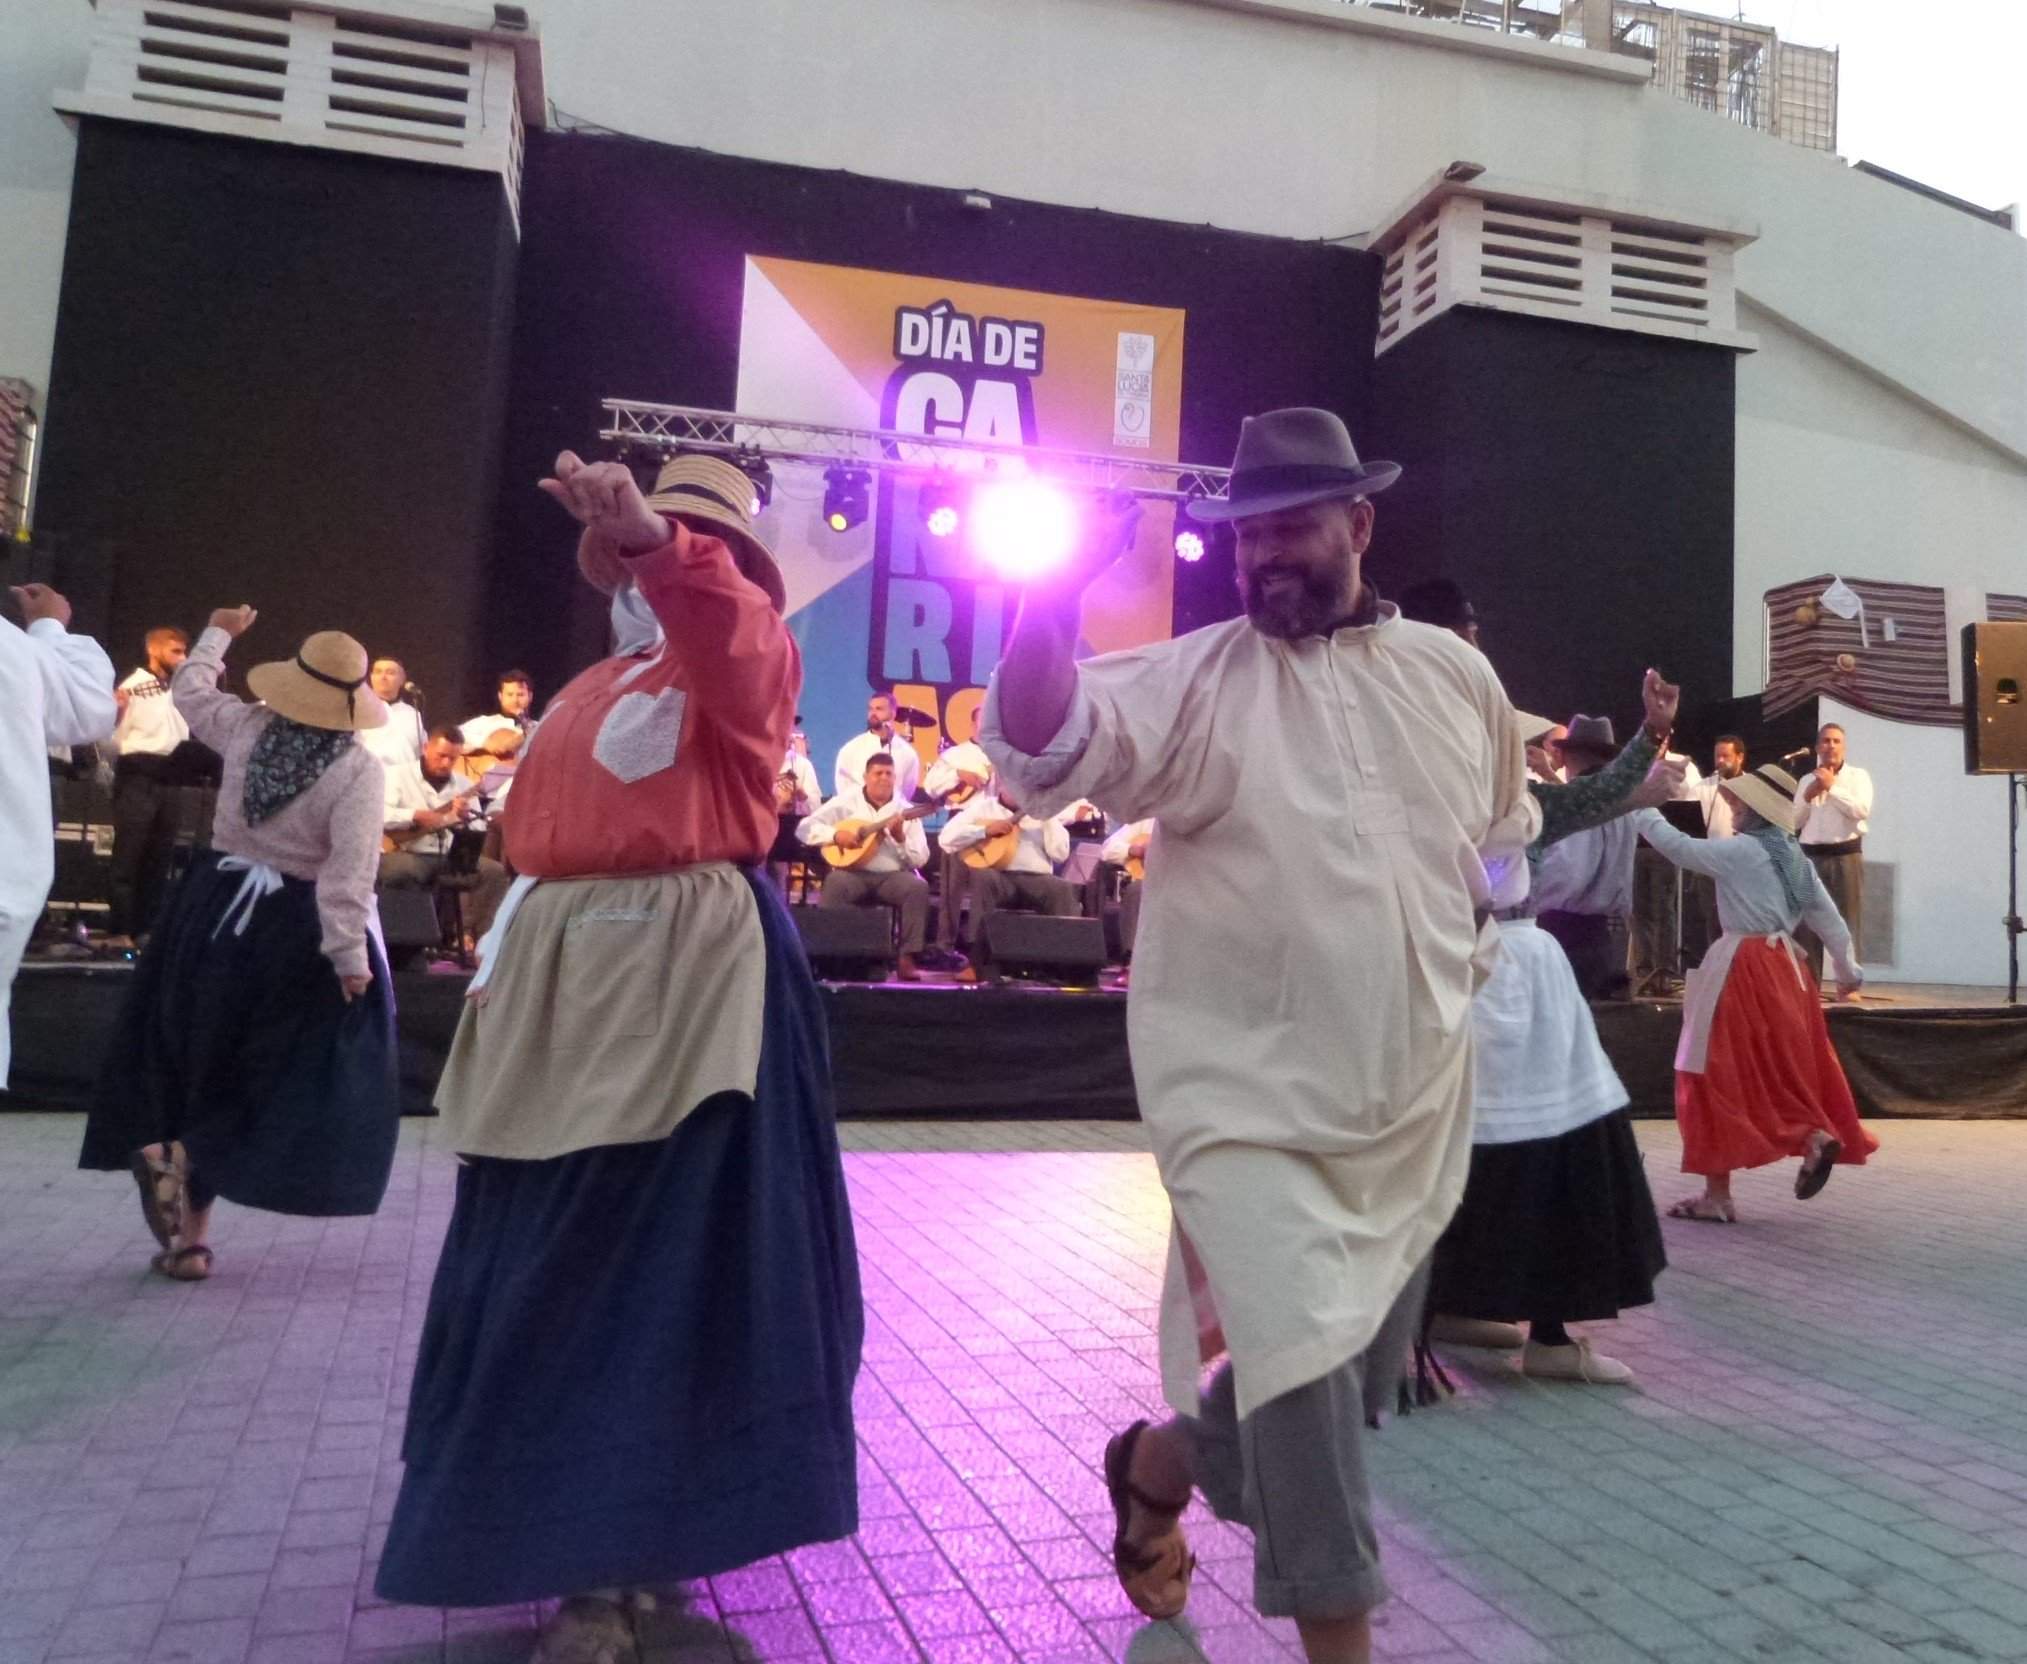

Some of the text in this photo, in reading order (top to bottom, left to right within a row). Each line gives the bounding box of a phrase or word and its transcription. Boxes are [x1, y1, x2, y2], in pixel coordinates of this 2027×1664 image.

[900, 305, 1038, 370] DÍA DE
[895, 371, 1028, 474] CA
[882, 577, 1005, 685] RI
